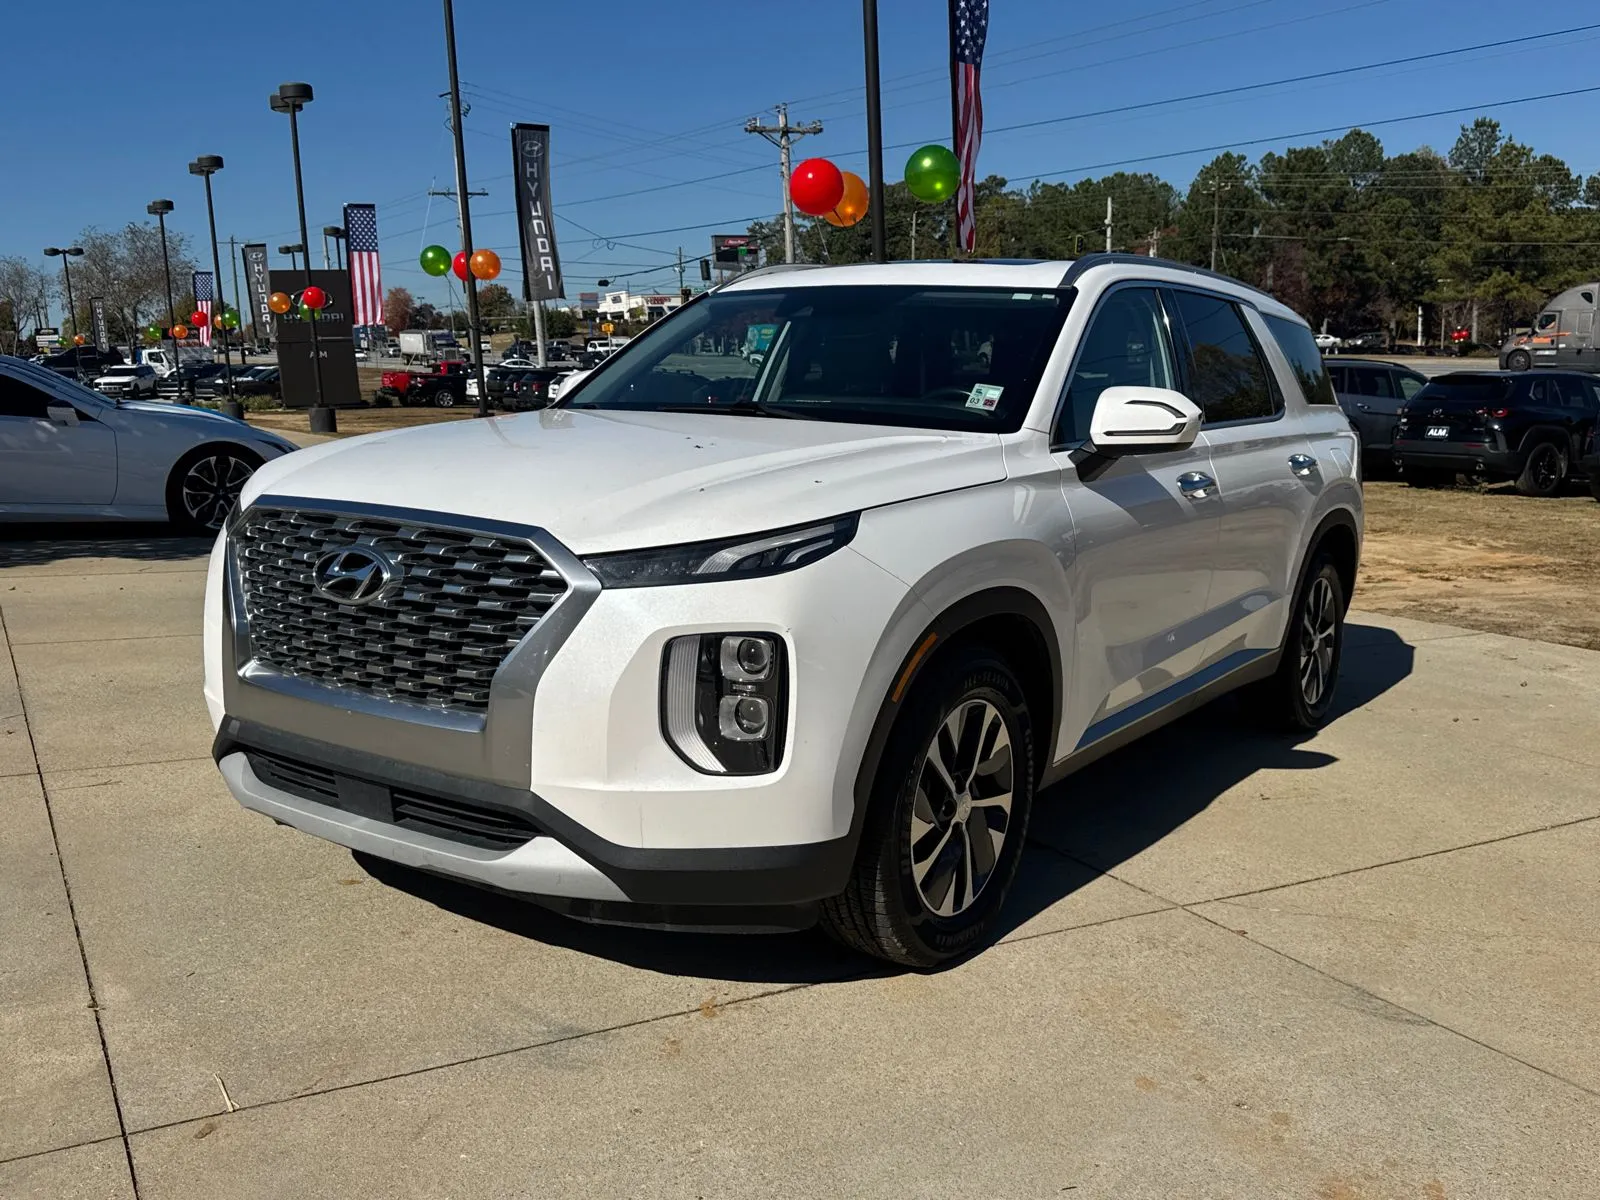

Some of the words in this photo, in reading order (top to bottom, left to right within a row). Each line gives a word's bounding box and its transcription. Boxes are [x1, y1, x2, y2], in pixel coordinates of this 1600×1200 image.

[526, 161, 554, 290] HYUNDAI
[254, 263, 271, 333] HYUNDAI
[283, 312, 345, 323] HYDAI
[96, 307, 107, 349] HYUNDAI
[309, 350, 328, 359] AM
